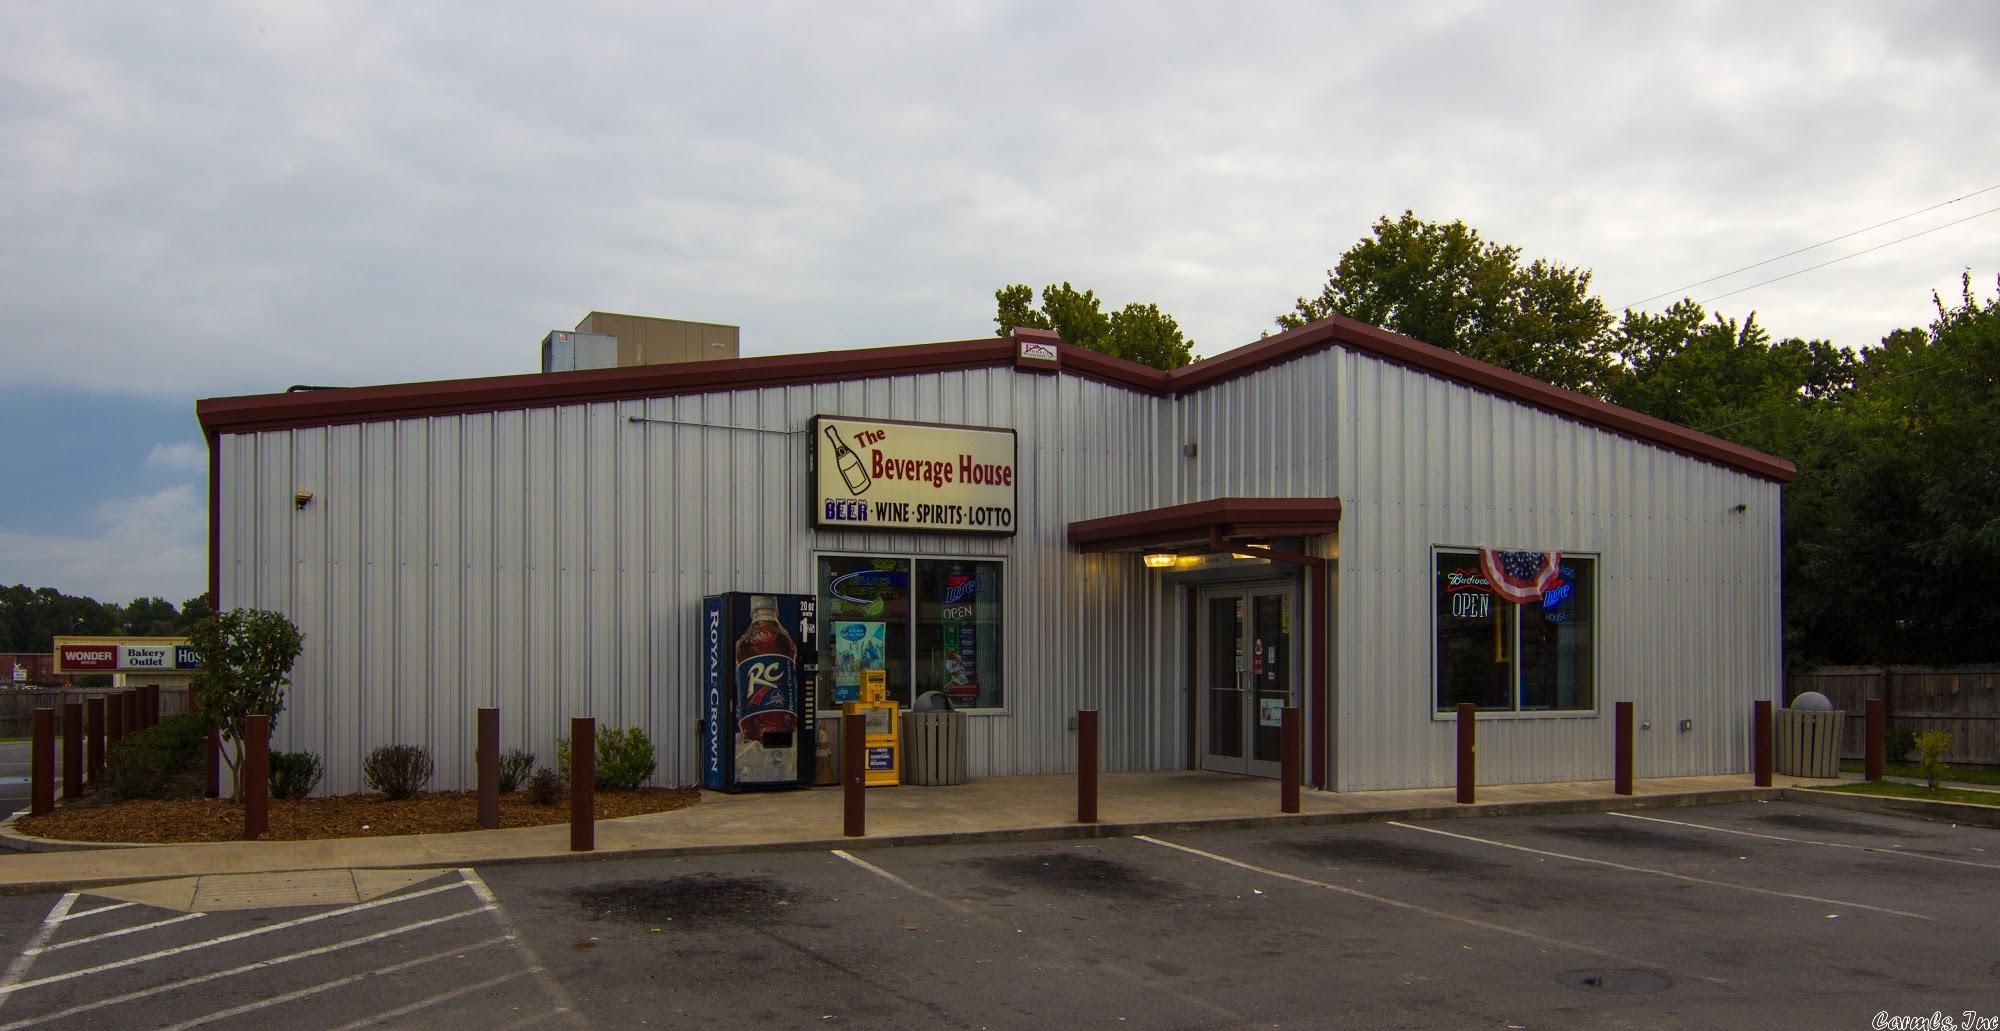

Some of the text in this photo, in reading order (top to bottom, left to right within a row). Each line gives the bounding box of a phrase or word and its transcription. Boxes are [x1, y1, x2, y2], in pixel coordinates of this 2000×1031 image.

[854, 429, 886, 448] The
[872, 449, 1012, 488] Beverage House
[825, 498, 1012, 526] BEER WINE SPIRITS LOTTO
[943, 605, 973, 620] OPEN
[1453, 593, 1489, 618] OPEN
[65, 651, 112, 661] WONDER
[127, 649, 165, 658] Bakery
[129, 658, 162, 666] Outlet
[709, 610, 719, 772] ROYAL CROWN
[747, 662, 784, 699] RC
